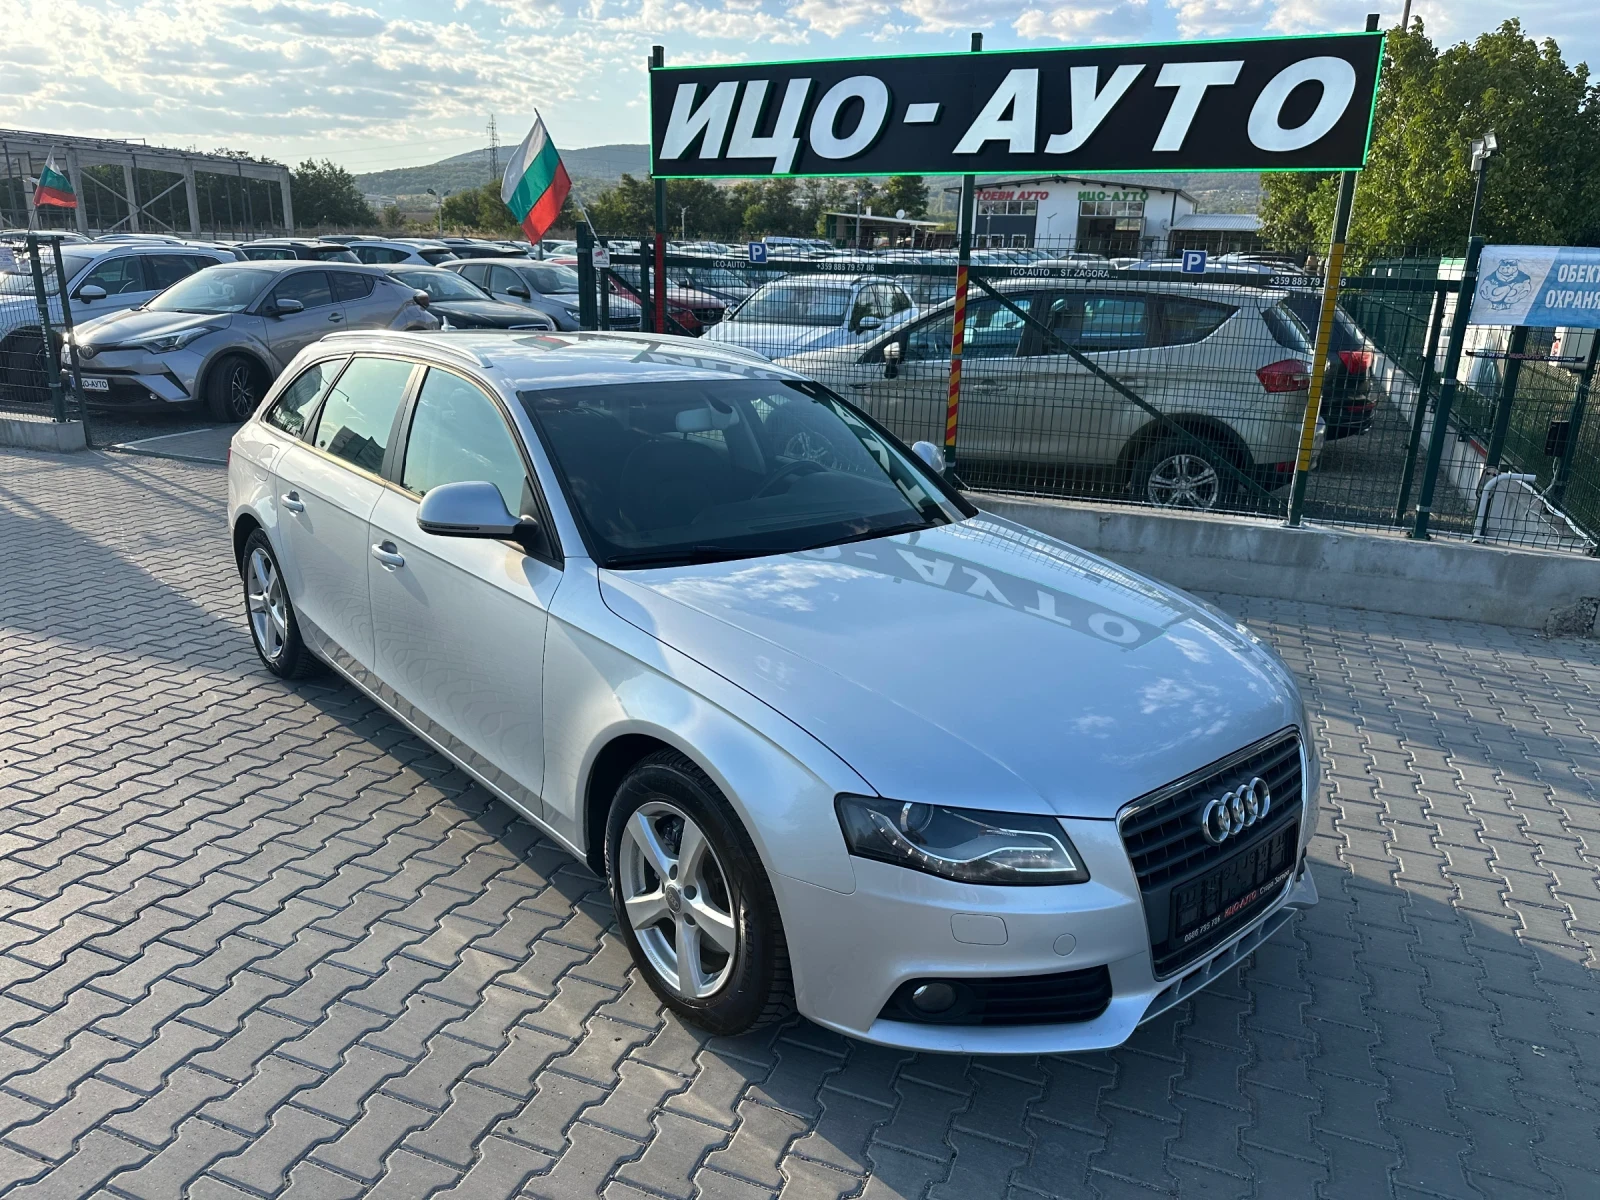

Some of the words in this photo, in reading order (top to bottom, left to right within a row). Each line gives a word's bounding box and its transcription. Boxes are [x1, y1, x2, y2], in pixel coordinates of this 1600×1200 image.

[659, 56, 1356, 174] ИЦО-АУТО
[974, 190, 1015, 201] ТОЕВИ
[1017, 190, 1049, 201] АУТО
[1078, 190, 1149, 202] ИЦО-АУТО
[816, 263, 832, 271] +359
[833, 263, 846, 271] 886
[847, 264, 856, 272] 79
[866, 264, 875, 272] 86
[1073, 269, 1109, 278] ZAGORA
[1269, 276, 1290, 285] +359
[1291, 277, 1308, 286] 886
[1310, 277, 1321, 286] 79
